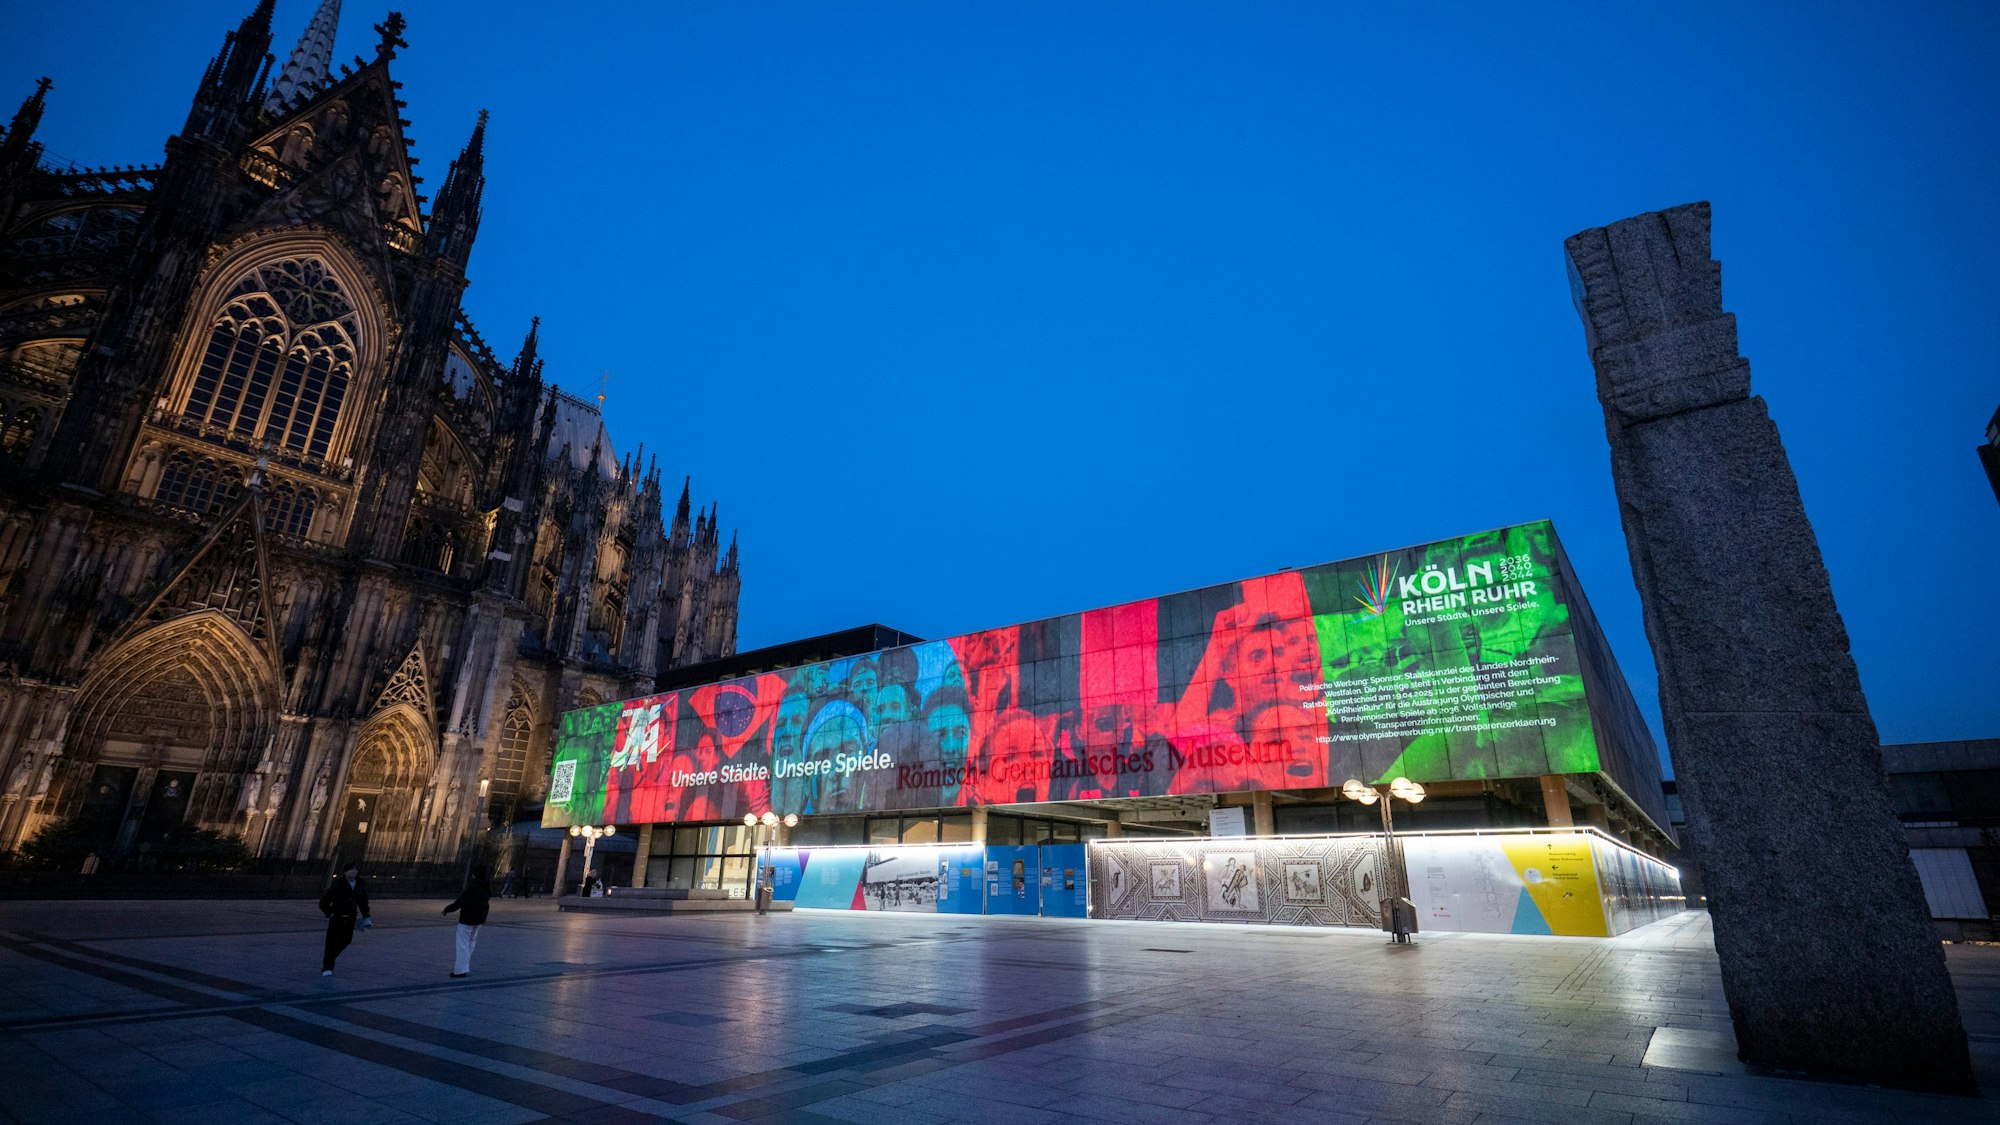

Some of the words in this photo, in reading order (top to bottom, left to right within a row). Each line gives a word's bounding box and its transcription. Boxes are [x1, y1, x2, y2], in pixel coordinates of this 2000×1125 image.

[1500, 554, 1530, 566] 2036
[1501, 561, 1532, 574] 2040
[1399, 561, 1494, 599] KÖLN
[1502, 569, 1534, 582] 2044
[1402, 592, 1466, 616] RHEIN
[1471, 581, 1537, 605] RUHR
[1404, 615, 1436, 627] Unsere
[1437, 610, 1471, 622] Städte.
[1471, 606, 1505, 617] Unsere
[1507, 601, 1540, 612] Spiele.
[1333, 678, 1369, 689] Werbung:
[1404, 667, 1458, 679] Staatskanzlei
[1459, 665, 1474, 674] des
[1476, 661, 1508, 672] Landes
[1510, 655, 1559, 667] Nordrhein-
[1364, 685, 1378, 694] Die
[1378, 681, 1409, 692] Anzeige
[1410, 678, 1429, 688] steht
[1433, 677, 1441, 686] in
[1441, 673, 1490, 684] Verbindung
[1492, 670, 1506, 679] mit
[1507, 669, 1529, 678] dem
[1378, 694, 1391, 702] am
[1446, 685, 1461, 695] der
[1462, 682, 1507, 694] geplanten
[1508, 675, 1561, 688] Bewerbung
[1385, 701, 1397, 709] für
[1398, 698, 1411, 708] die
[1412, 695, 1459, 707] Austragung
[1460, 690, 1515, 703] Olympischer
[1516, 688, 1534, 697] und
[1341, 711, 1399, 724] Paralympischer
[1399, 708, 1425, 720] Spiele
[1426, 707, 1437, 715] ab
[1462, 701, 1517, 712] Vollständige
[1373, 714, 1480, 730] Transparenzinformationen:
[1316, 718, 1556, 744] http://wwwolympiabewerbung.nrw/transparenzerklaerung
[1167, 738, 1294, 771] Museum
[671, 769, 717, 788] Unsere
[719, 763, 771, 783] Städte.
[775, 758, 832, 779] Unsere
[834, 748, 895, 777] Spiele.
